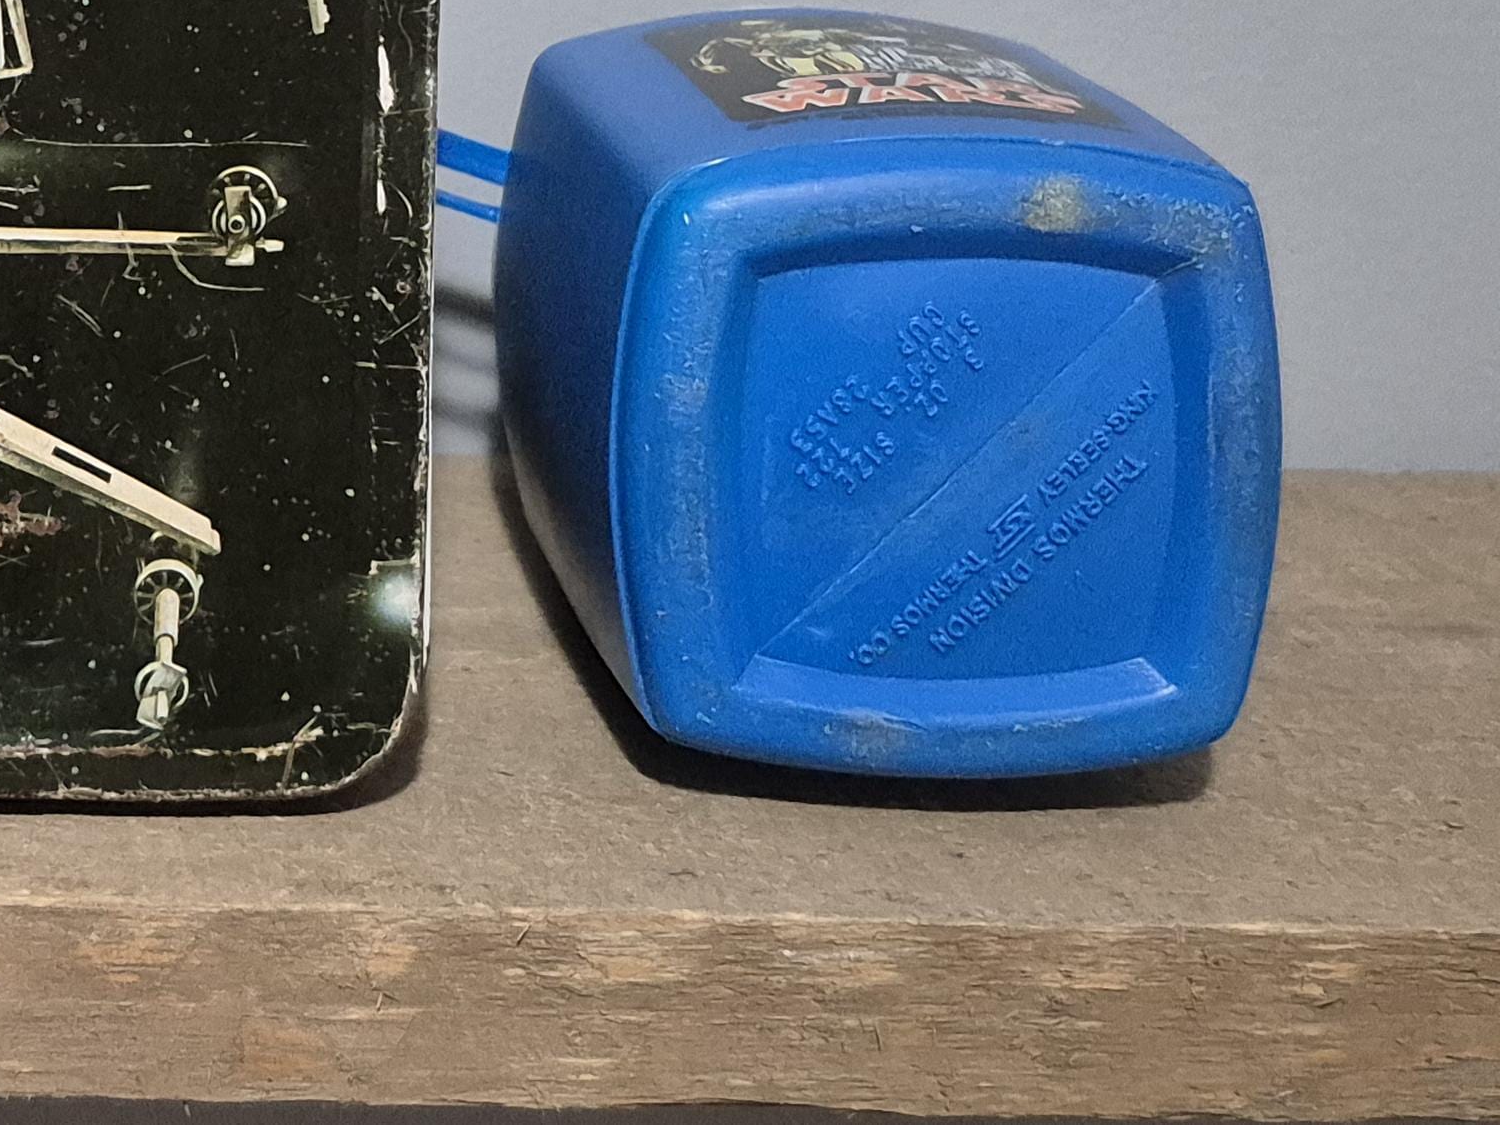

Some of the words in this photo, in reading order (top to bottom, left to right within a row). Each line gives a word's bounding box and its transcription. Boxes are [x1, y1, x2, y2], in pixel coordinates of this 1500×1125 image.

[741, 85, 1077, 115] WARS
[777, 72, 1083, 110] STAR
[870, 309, 981, 416] STOPPER
[898, 300, 945, 355] CUP
[833, 430, 895, 495] SIZE
[1033, 454, 1151, 562] THERMOS
[891, 548, 989, 636] THERMOS
[928, 558, 1034, 654] DIVISION
